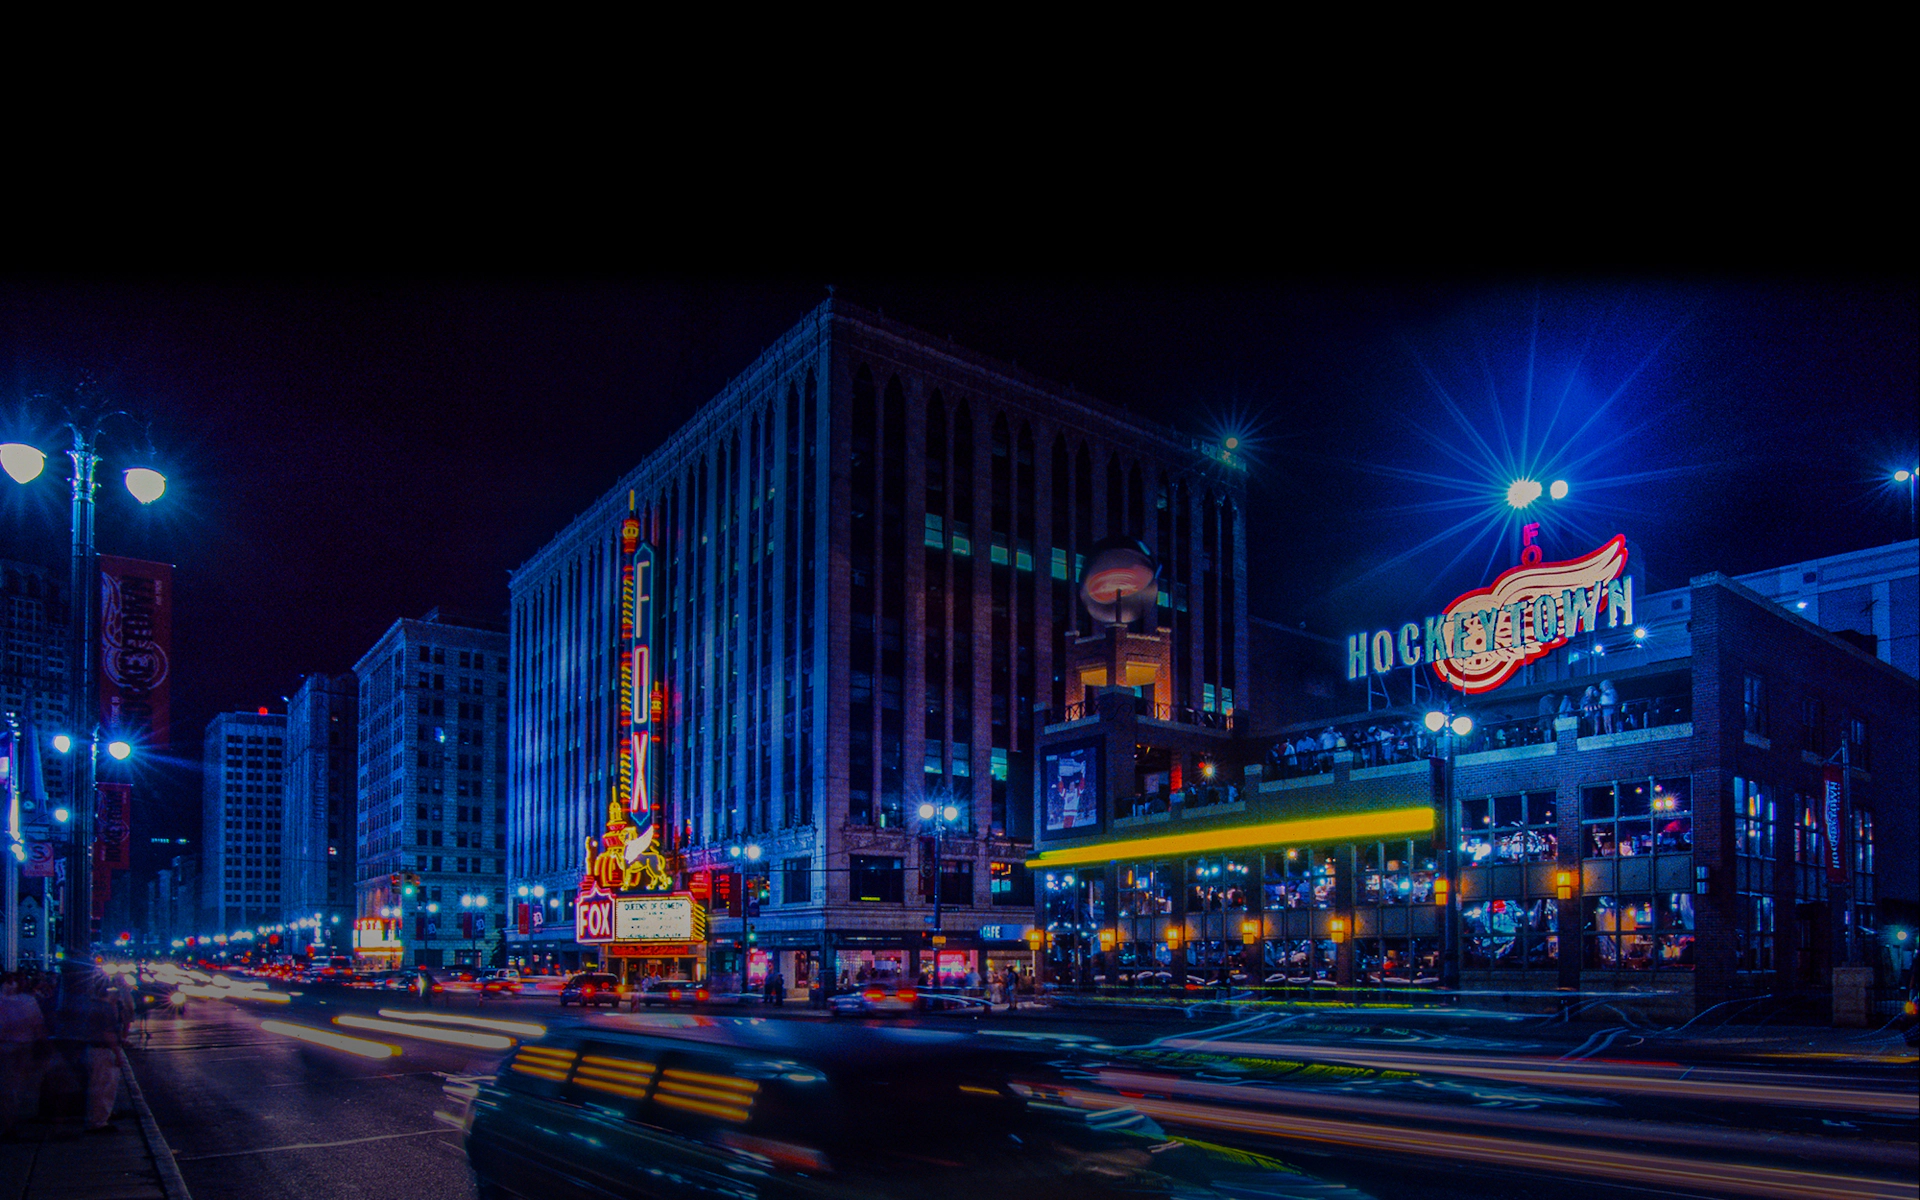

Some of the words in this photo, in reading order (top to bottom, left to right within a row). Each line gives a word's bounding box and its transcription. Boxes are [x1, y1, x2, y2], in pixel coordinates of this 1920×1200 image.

[1347, 574, 1634, 681] HOCKEYTOWN
[631, 561, 650, 813] FOX
[1828, 781, 1841, 869] HOCKEYTOWN
[579, 900, 611, 938] FOX
[625, 902, 647, 910] QUEENS
[651, 902, 658, 910] OF
[660, 902, 684, 910] COMEDY
[983, 926, 1001, 939] CAFE
